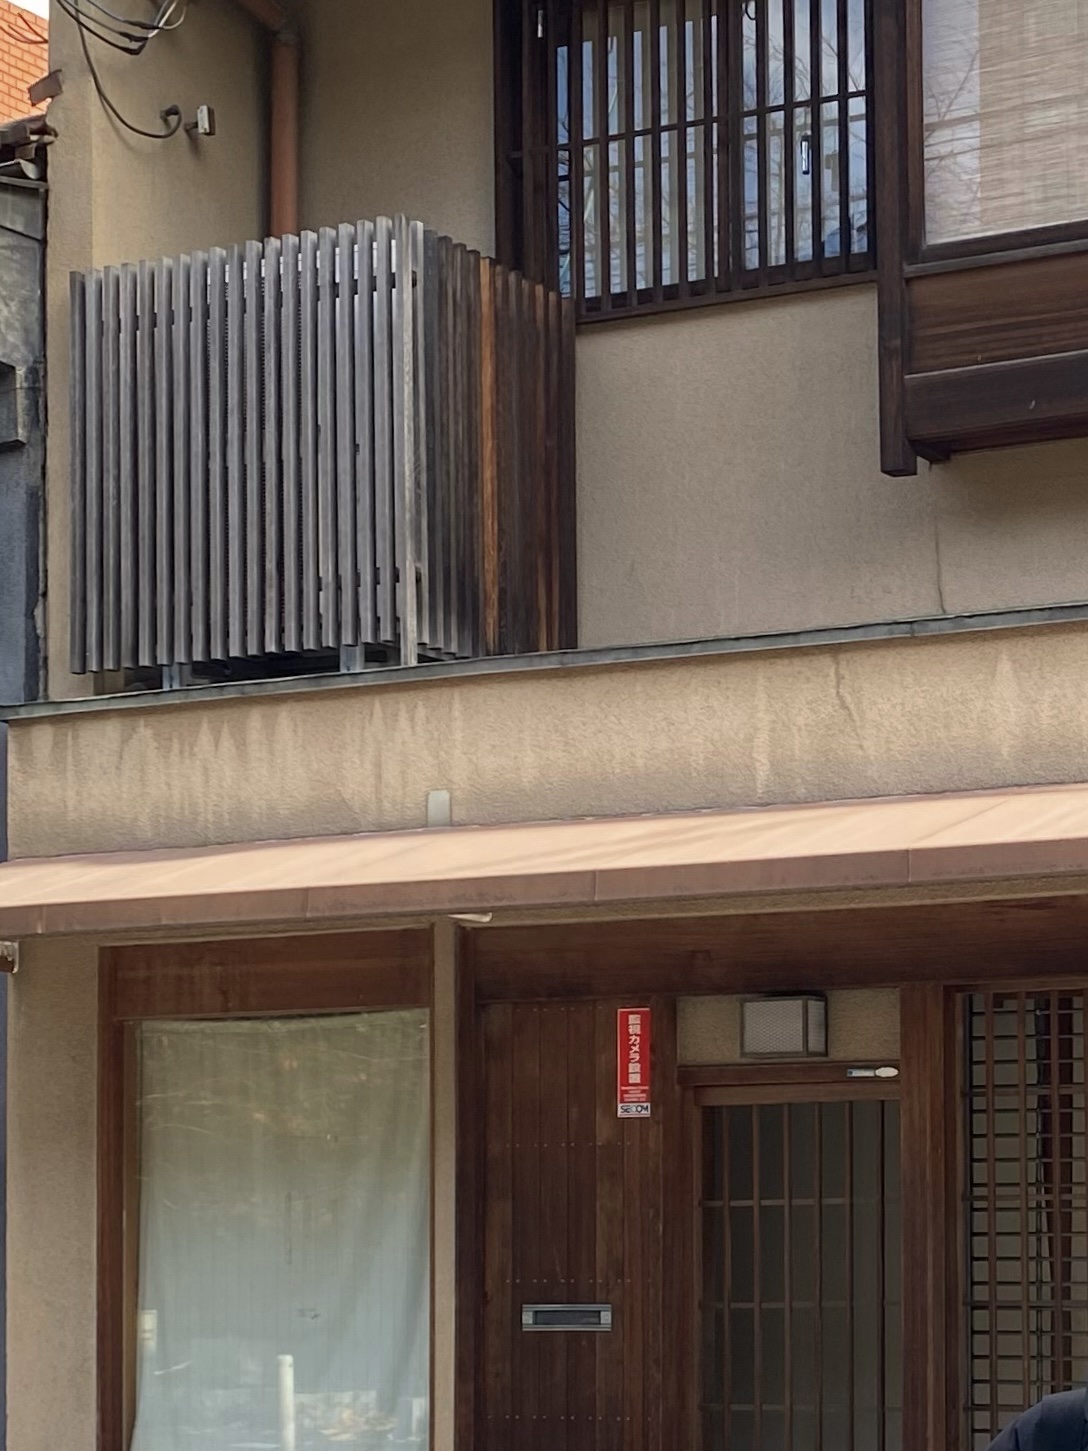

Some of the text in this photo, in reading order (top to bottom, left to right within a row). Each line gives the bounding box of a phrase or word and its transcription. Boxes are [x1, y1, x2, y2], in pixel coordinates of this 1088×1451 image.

[628, 1014, 641, 1084] 監視カメラ設置
[620, 1104, 649, 1113] SECOM
